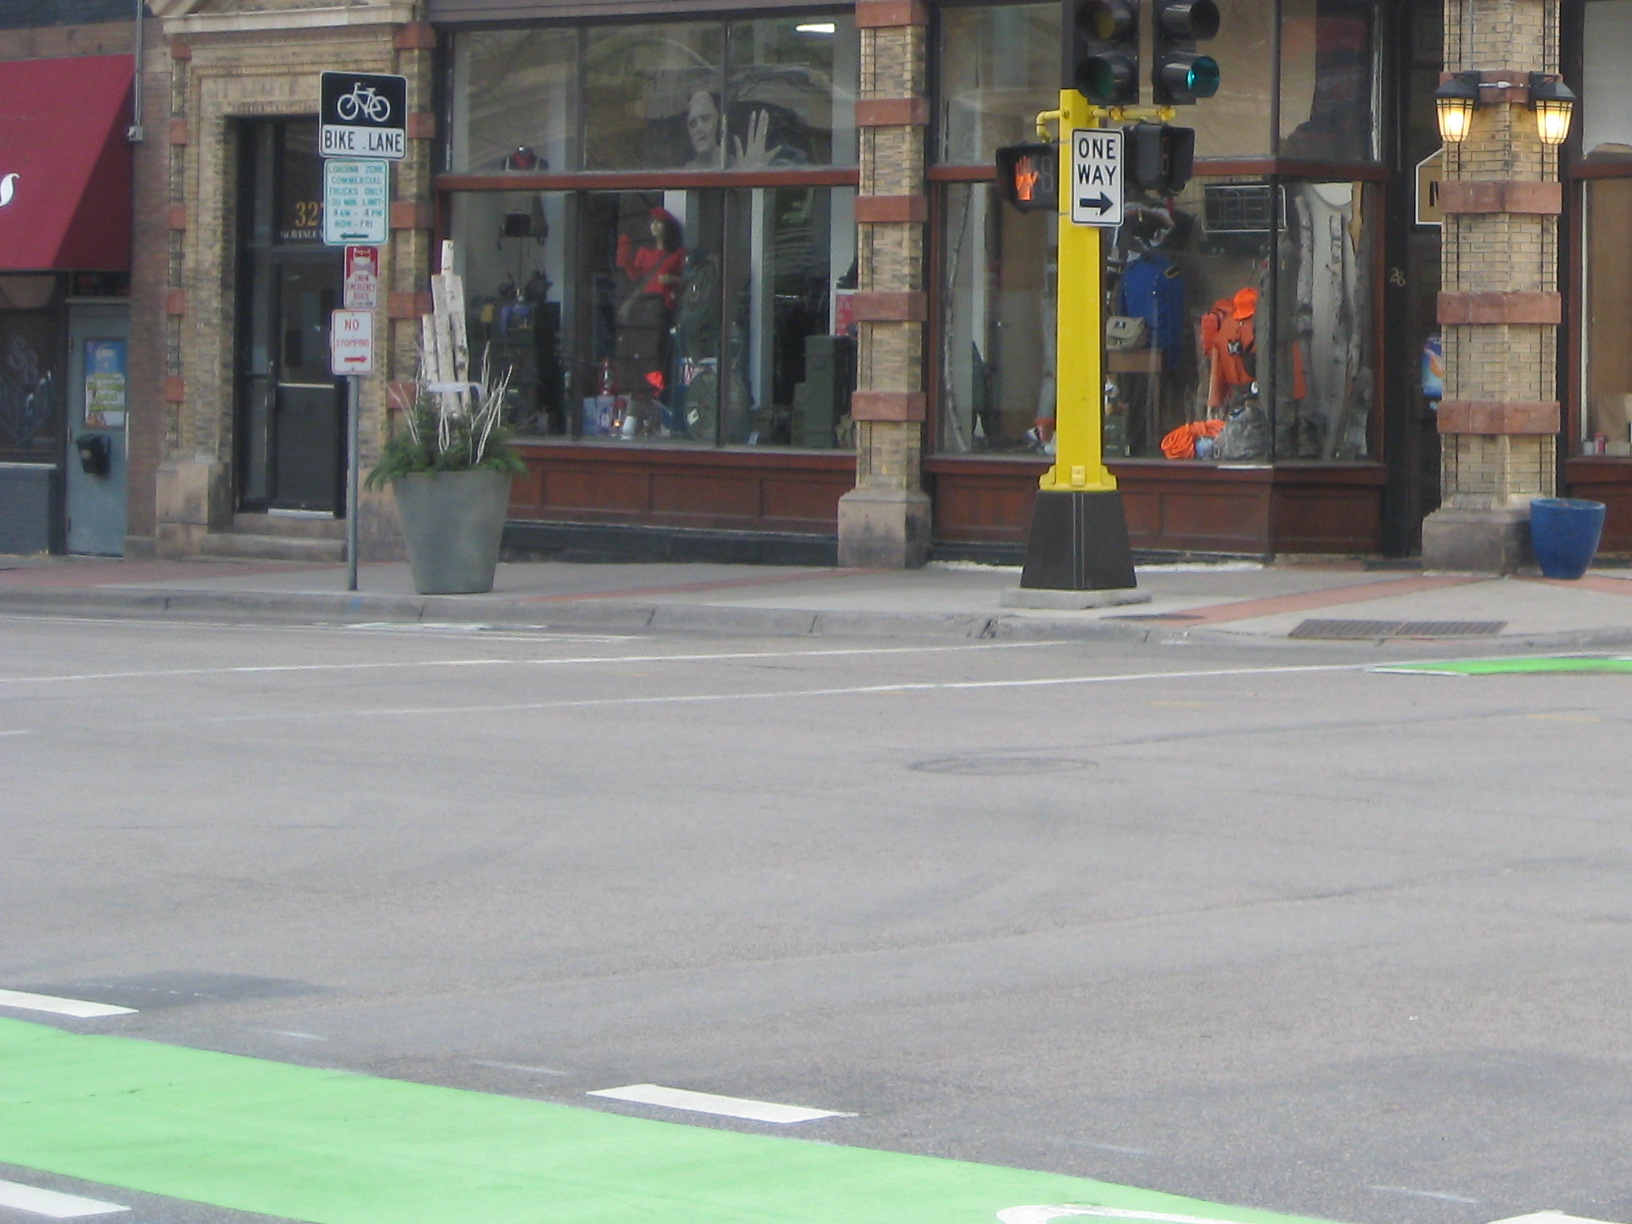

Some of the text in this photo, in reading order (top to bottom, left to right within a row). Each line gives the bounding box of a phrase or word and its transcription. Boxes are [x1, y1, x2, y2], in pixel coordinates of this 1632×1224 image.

[324, 130, 403, 152] BIKE LANE
[1078, 137, 1117, 160] ONE
[365, 165, 384, 174] ZONE
[1077, 163, 1117, 186] WAY
[331, 176, 382, 185] COMMERCIAL
[329, 187, 384, 195] TRUCKS ONLY
[331, 198, 341, 206] 30
[295, 201, 324, 227] 32
[344, 319, 360, 331] NO
[336, 339, 370, 347] STOPPING
